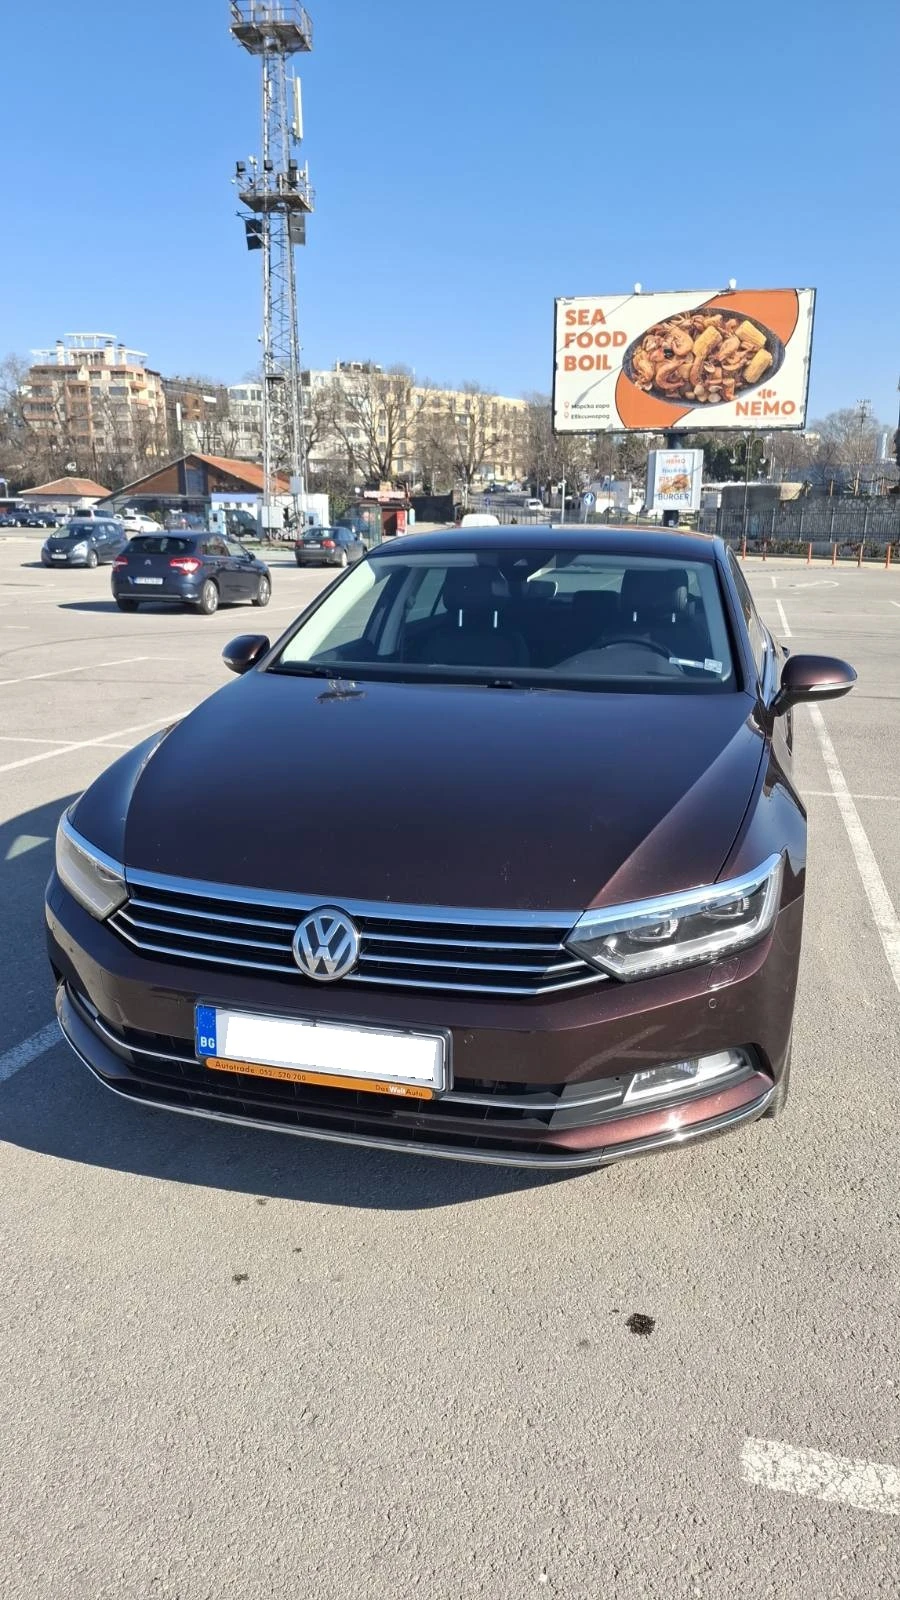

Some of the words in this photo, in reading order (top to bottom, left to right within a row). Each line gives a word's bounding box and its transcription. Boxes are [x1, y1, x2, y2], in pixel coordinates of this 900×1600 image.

[565, 308, 607, 326] SEA
[564, 331, 627, 349] FOOD
[564, 354, 613, 372] BOIL
[735, 400, 796, 416] NEMO
[658, 493, 690, 501] BURGER
[293, 909, 359, 980] VW
[200, 1036, 215, 1049] BG
